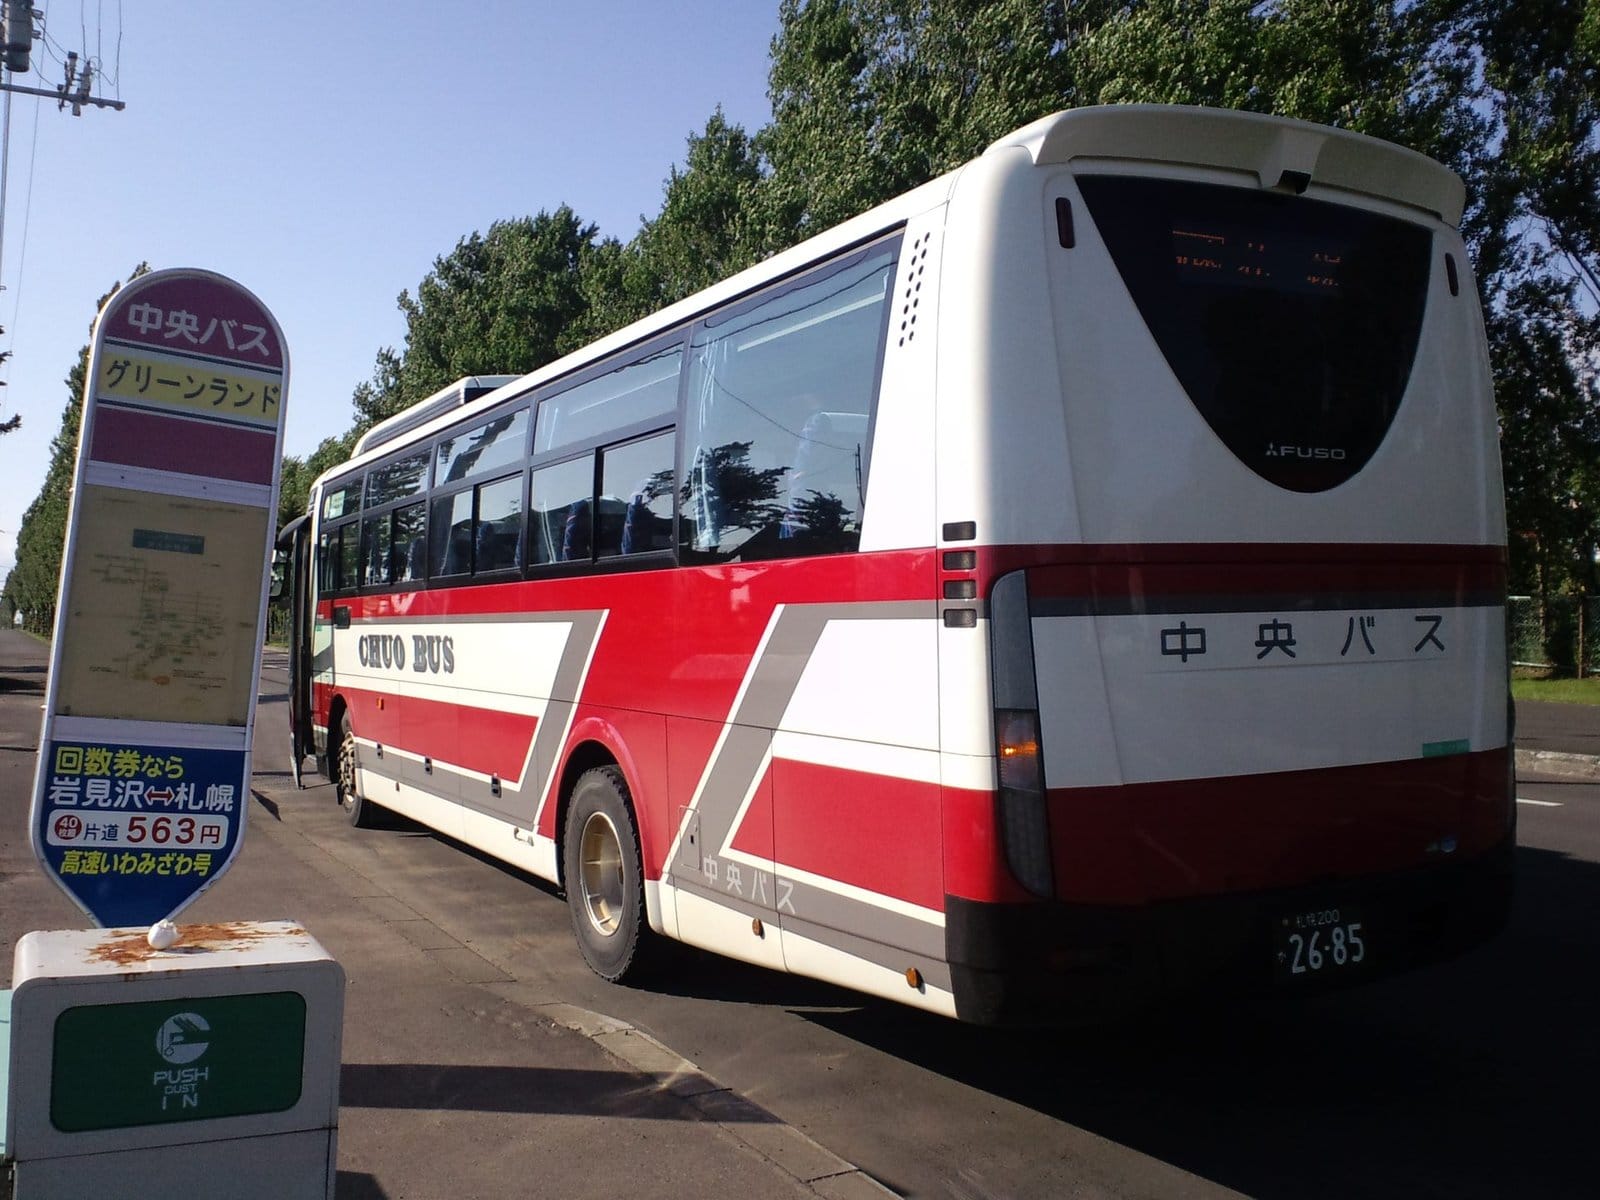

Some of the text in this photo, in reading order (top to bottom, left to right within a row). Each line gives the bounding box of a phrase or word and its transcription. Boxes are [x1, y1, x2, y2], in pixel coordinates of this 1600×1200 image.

[128, 302, 270, 356] 中央バス
[106, 359, 279, 413] グリーンランド
[1280, 446, 1346, 460] FUSO
[358, 634, 455, 674] CHUO BUS
[1161, 615, 1445, 663] 中央バス
[55, 746, 184, 779] 回数券なら
[49, 776, 235, 813] 岩見沢 札幌
[59, 817, 78, 828] 40
[83, 822, 120, 842] 片道
[60, 850, 212, 877] 高速いわみざわ号
[703, 854, 796, 915] 中央バス
[153, 1066, 209, 1086] PUSH
[164, 1083, 198, 1095] DUST
